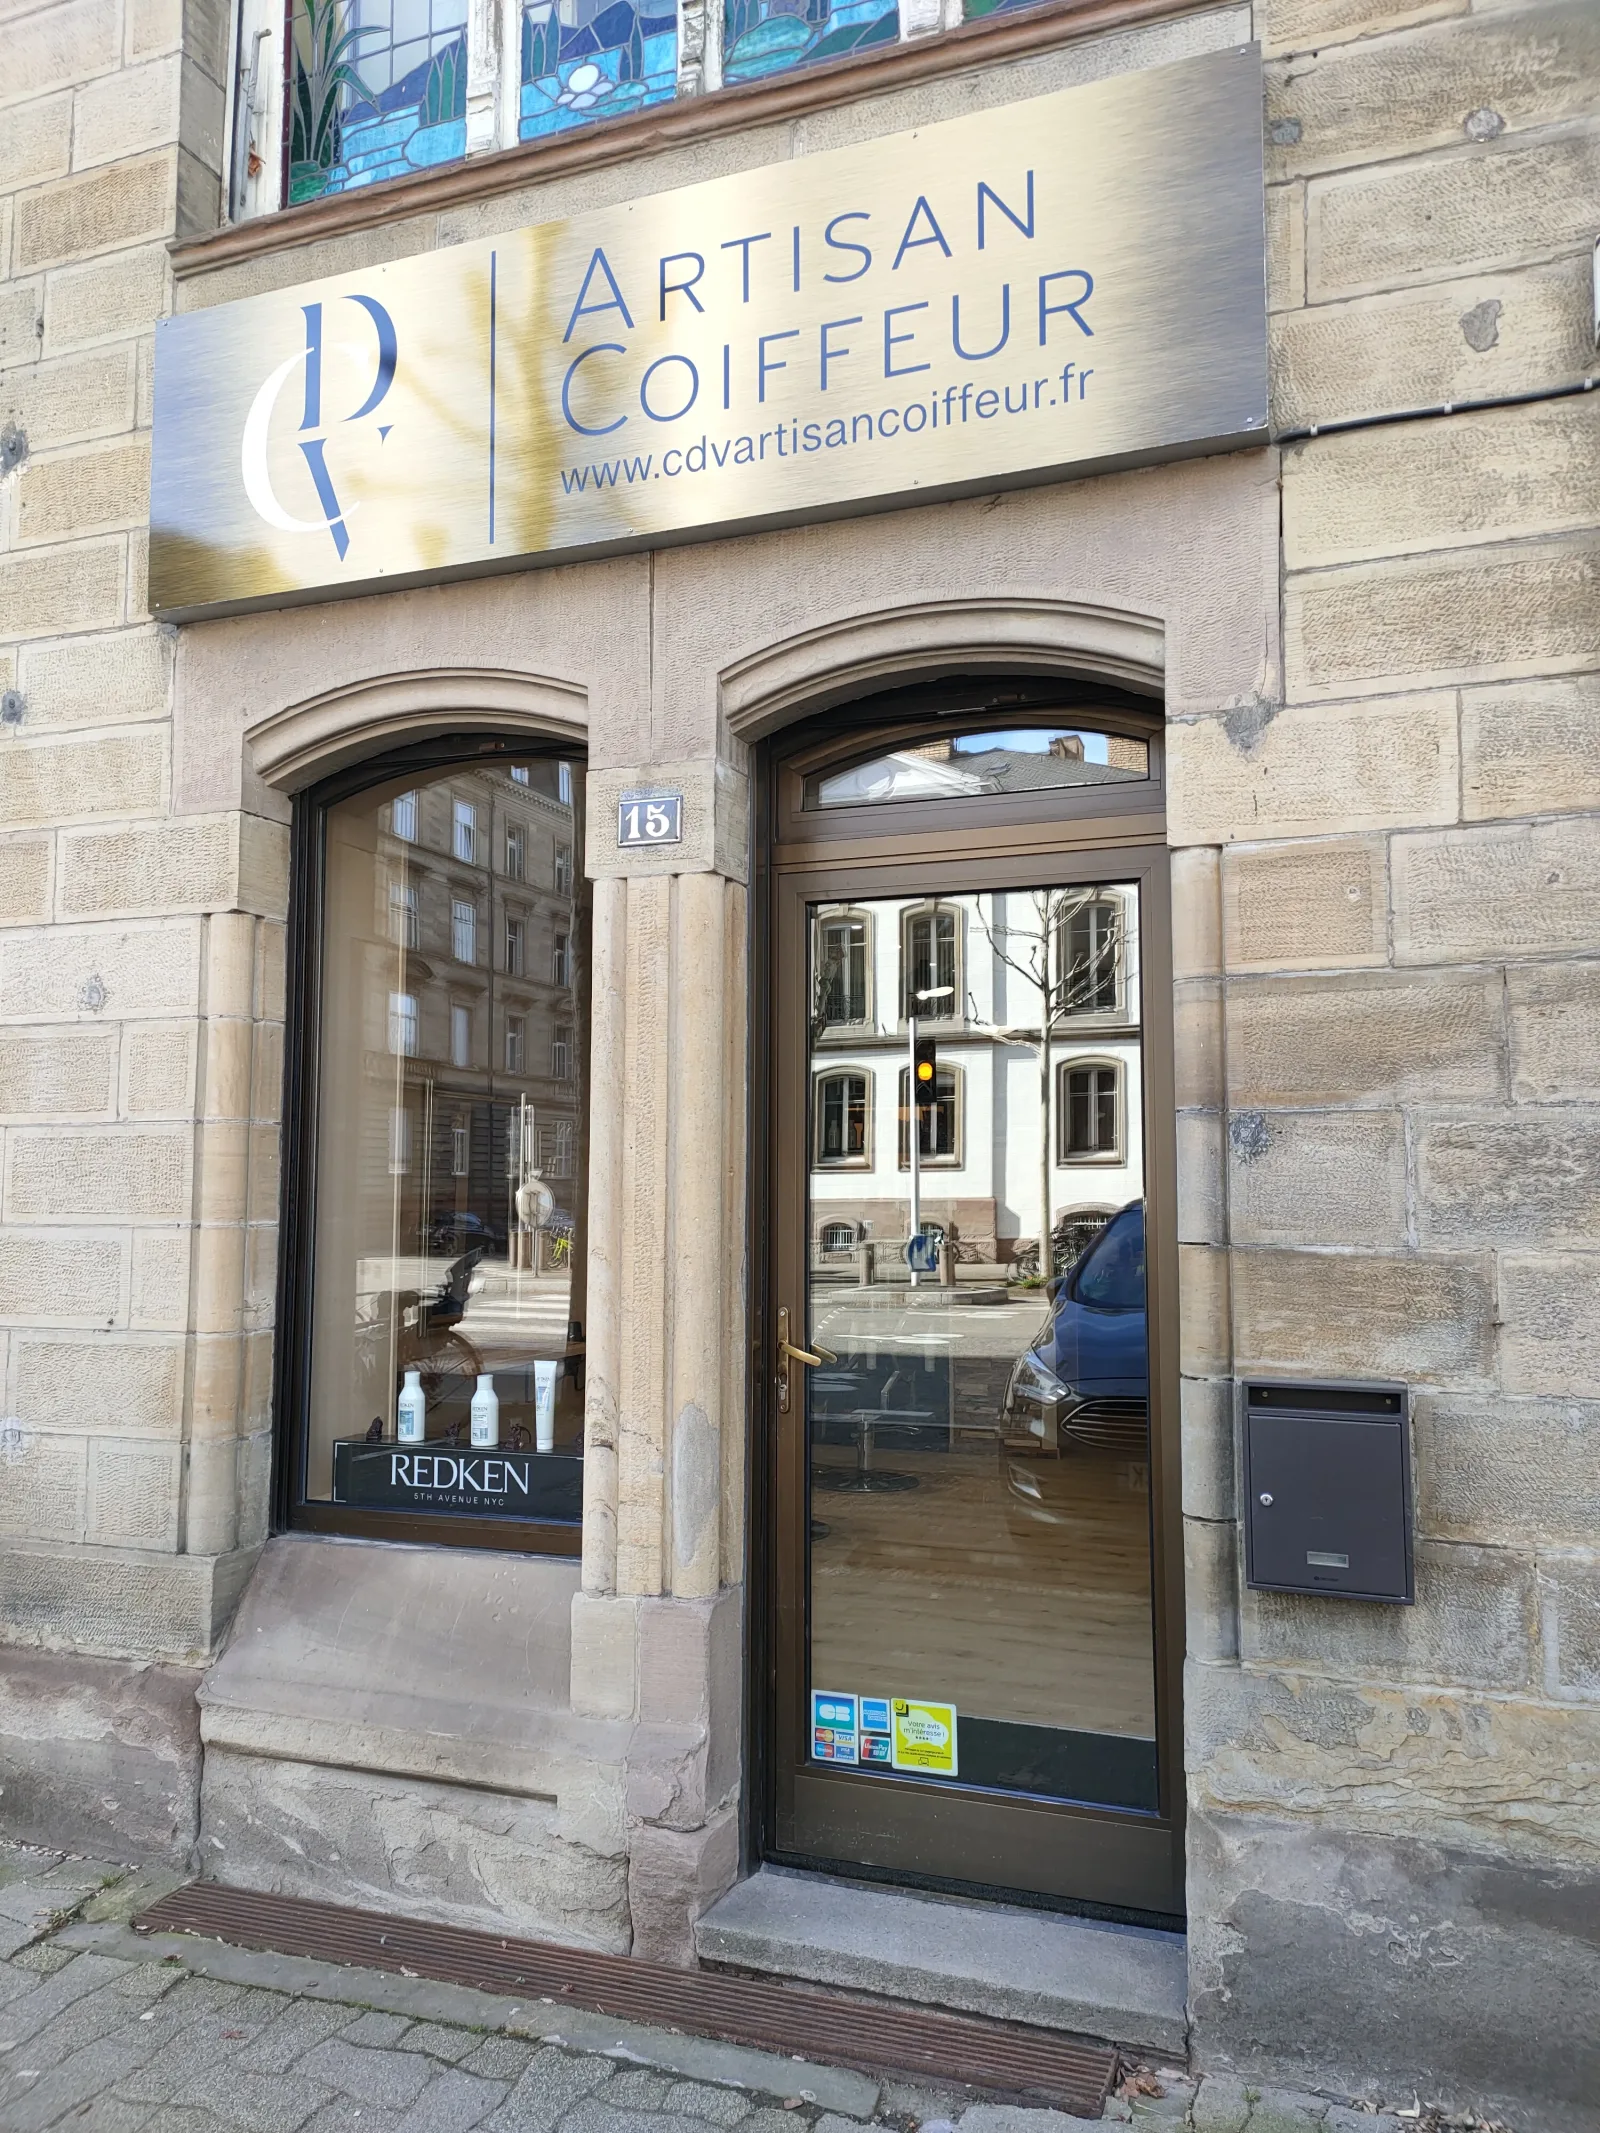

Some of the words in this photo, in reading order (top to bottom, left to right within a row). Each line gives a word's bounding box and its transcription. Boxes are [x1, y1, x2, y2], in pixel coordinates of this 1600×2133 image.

[562, 168, 1036, 343] ARTISAN
[560, 269, 1096, 438] COIFFEUR
[560, 362, 1095, 495] www.cdvartisancoiffeur.fr
[625, 804, 670, 839] 15
[390, 1454, 530, 1495] REDKEN
[414, 1493, 433, 1501] 5TH
[438, 1494, 478, 1504] AVENUE
[484, 1497, 505, 1506] NYC
[819, 1703, 851, 1721] CB
[908, 1720, 925, 1728] Votre
[926, 1722, 940, 1730] avis
